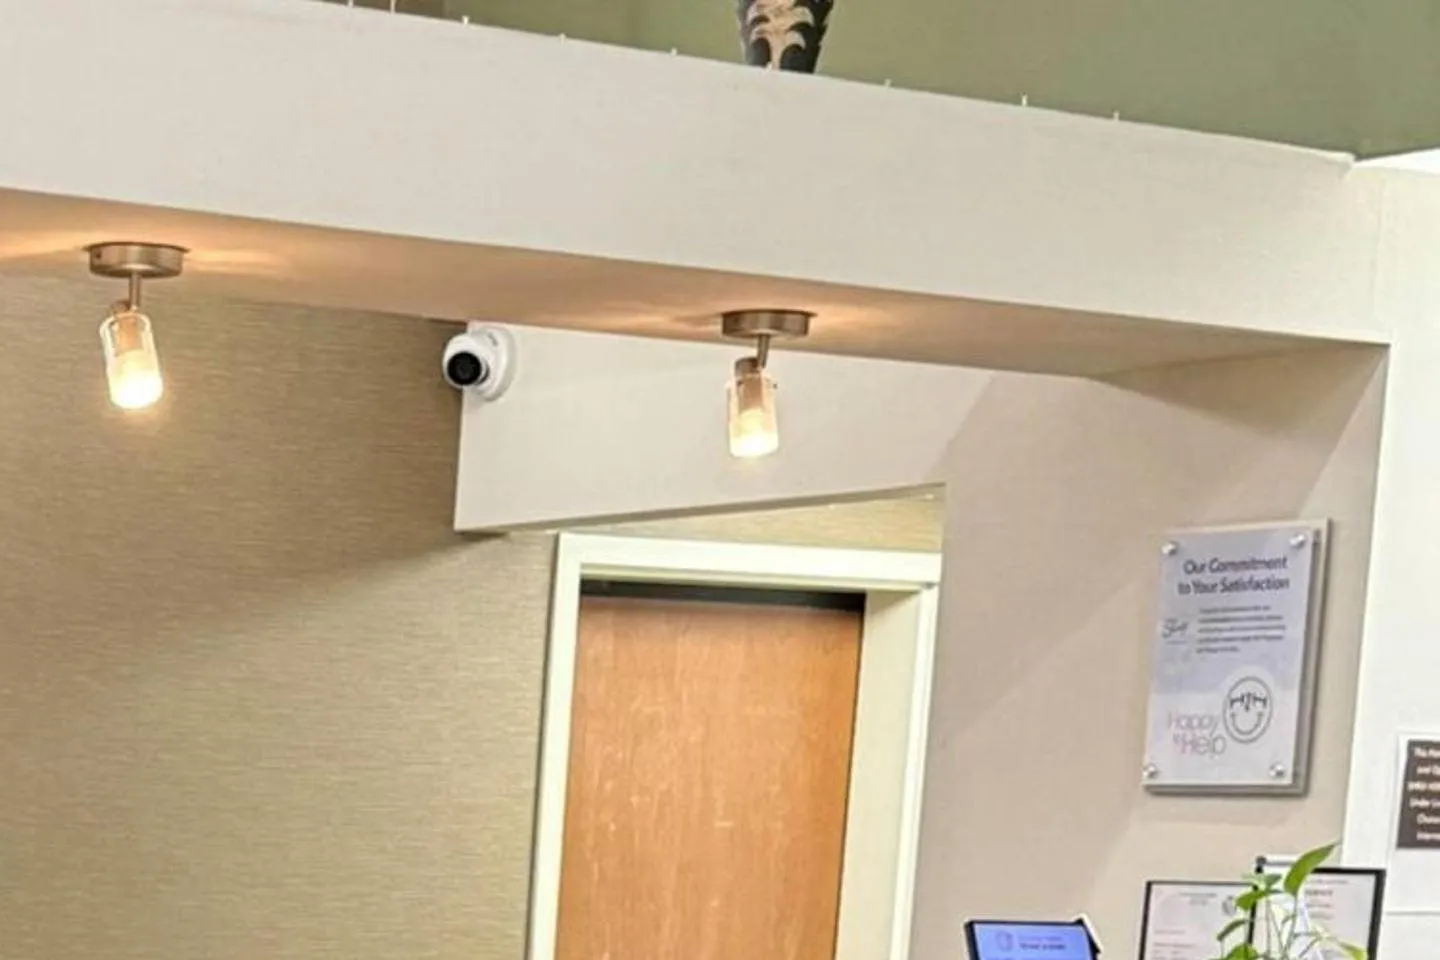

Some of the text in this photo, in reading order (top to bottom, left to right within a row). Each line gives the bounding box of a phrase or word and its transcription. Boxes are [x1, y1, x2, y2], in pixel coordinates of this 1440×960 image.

[1183, 556, 1287, 574] Our Commitment
[1178, 575, 1289, 595] to Your Satisfaction
